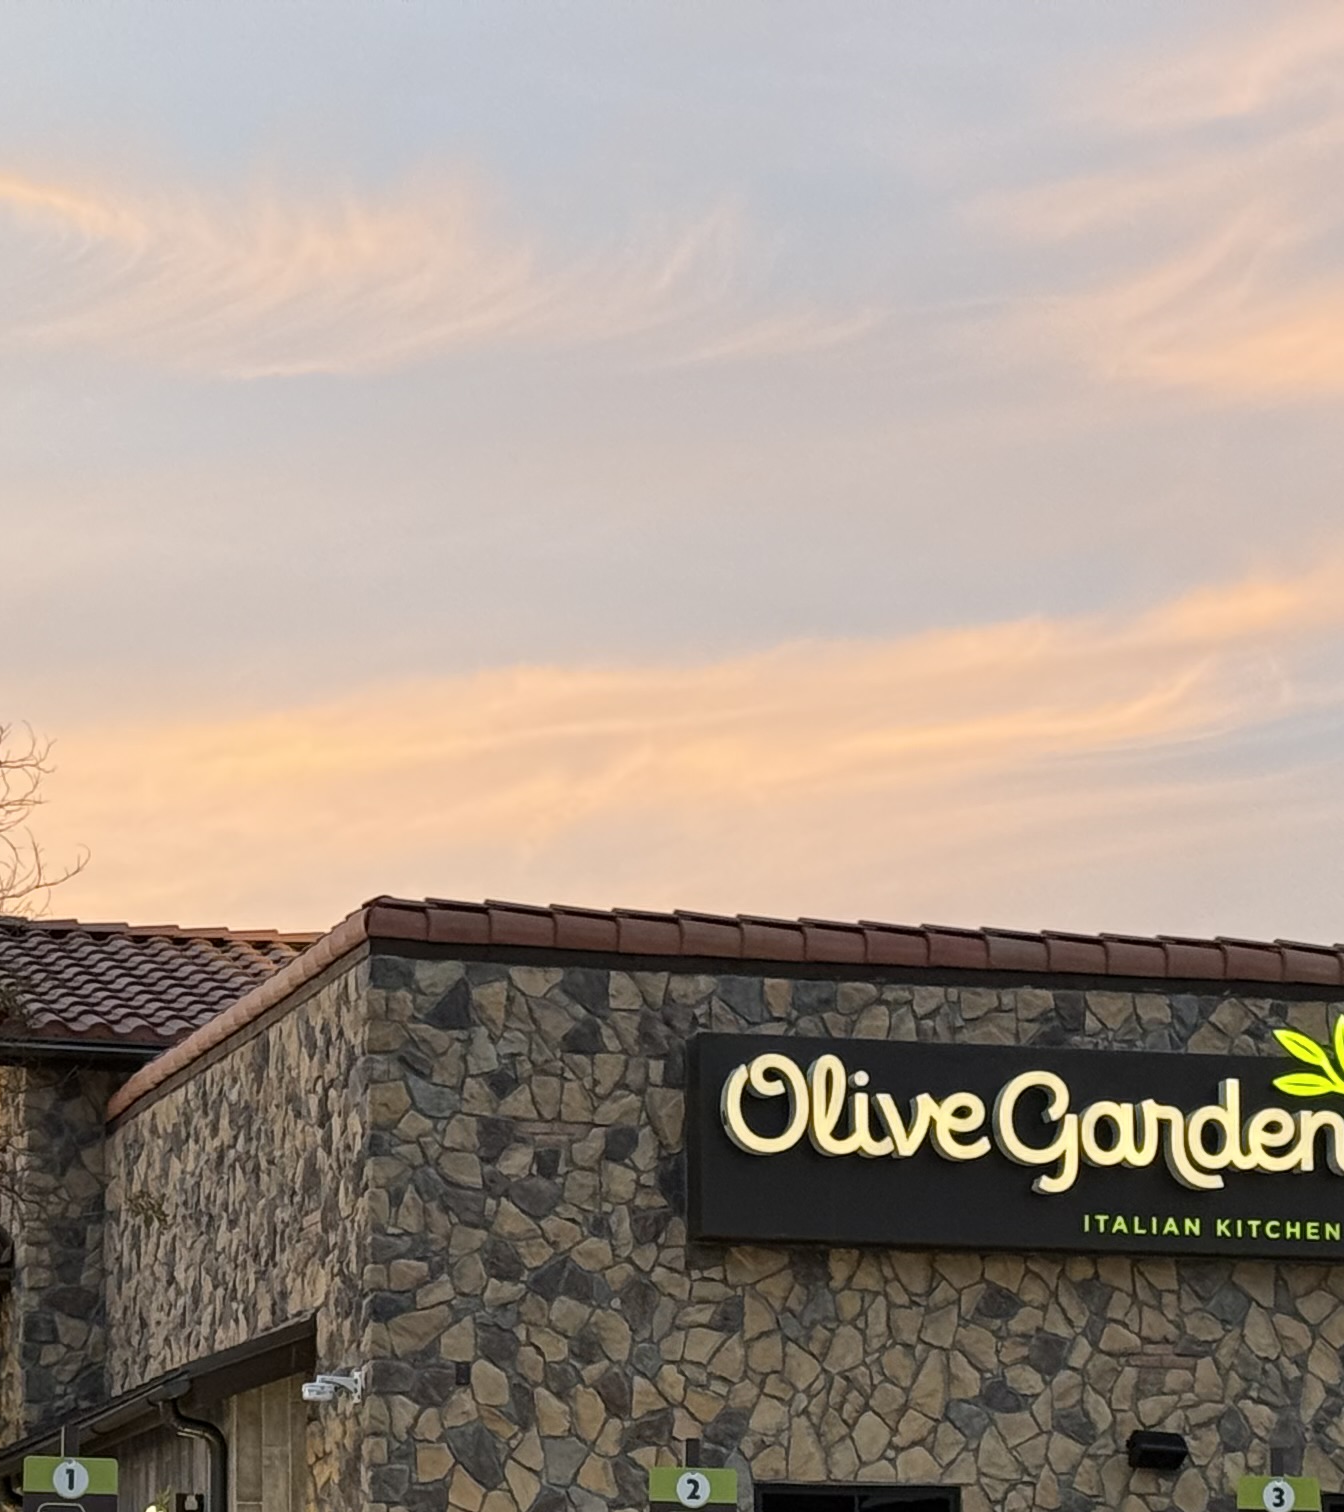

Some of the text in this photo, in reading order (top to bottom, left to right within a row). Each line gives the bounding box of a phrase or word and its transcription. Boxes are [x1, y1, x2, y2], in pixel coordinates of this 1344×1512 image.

[720, 1052, 991, 1163] Olive
[1082, 1213, 1343, 1242] ITALIAN KITCHEN
[66, 1469, 75, 1491] 1
[686, 1478, 701, 1500] 2
[1272, 1487, 1285, 1508] 3
